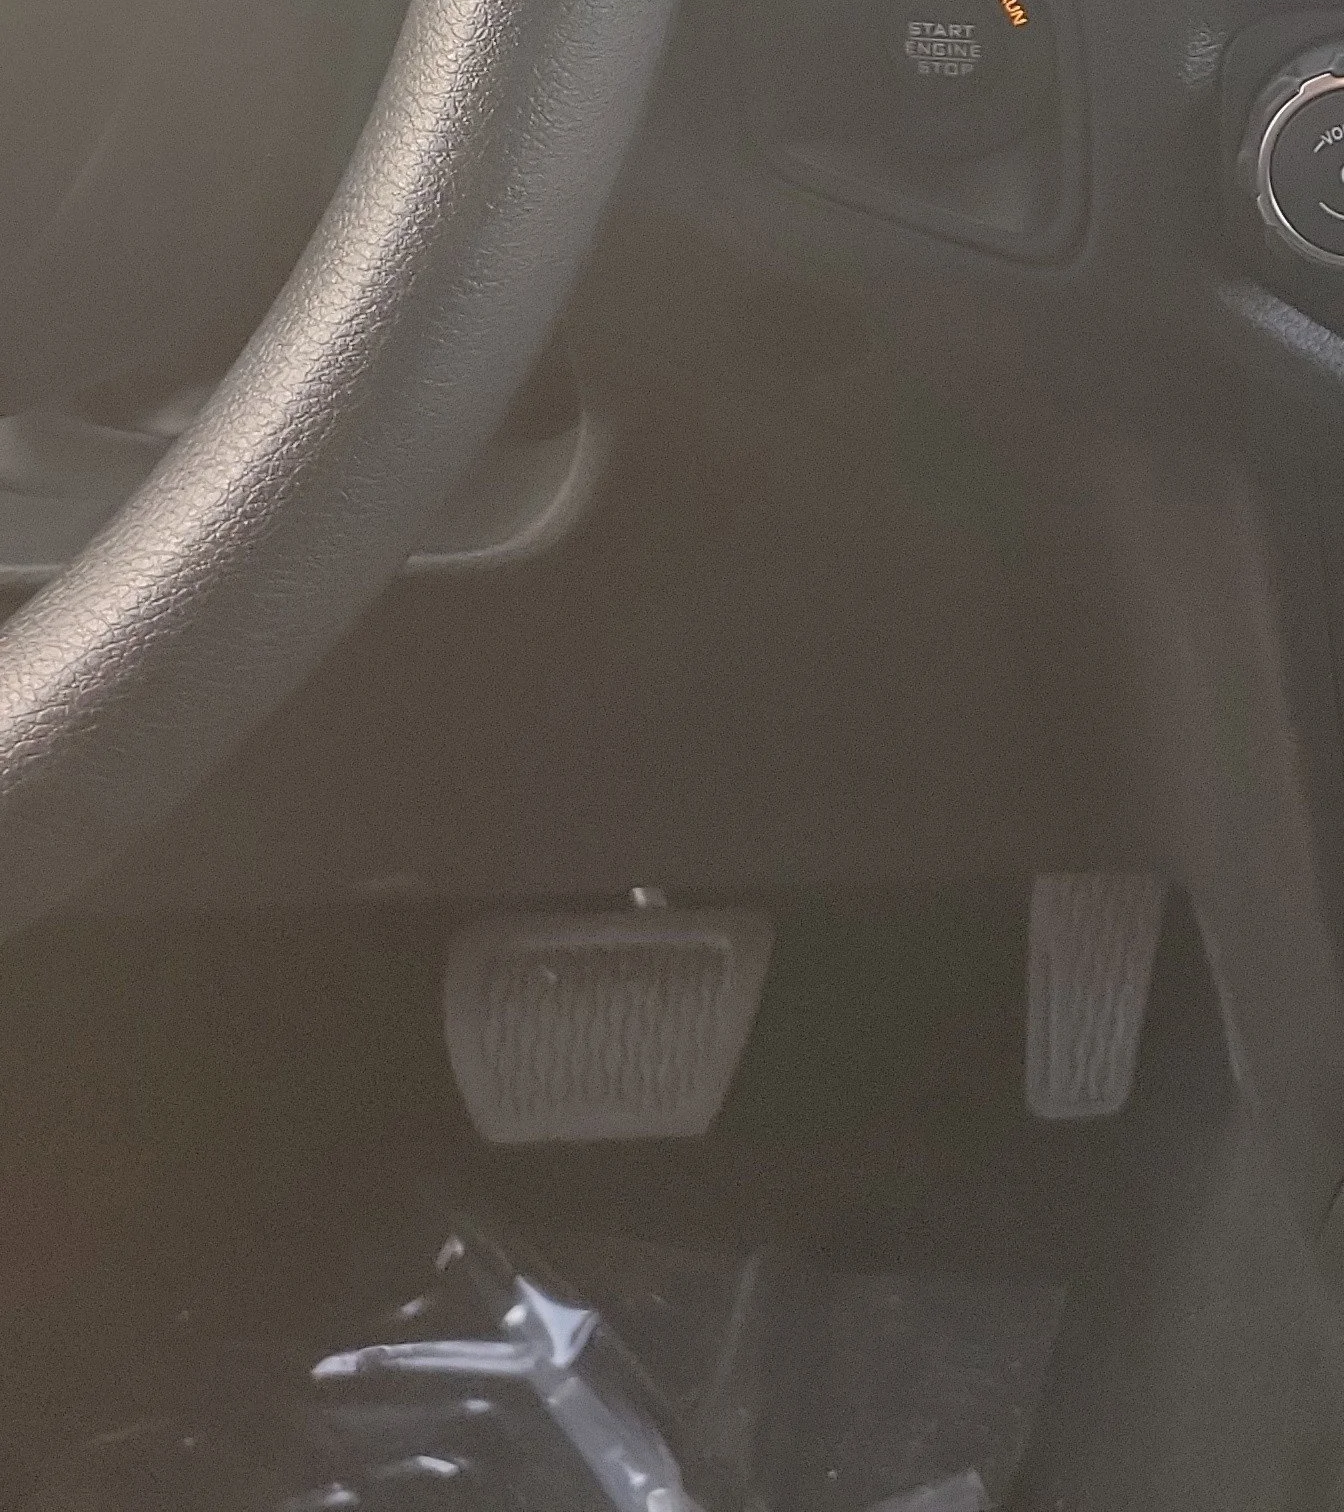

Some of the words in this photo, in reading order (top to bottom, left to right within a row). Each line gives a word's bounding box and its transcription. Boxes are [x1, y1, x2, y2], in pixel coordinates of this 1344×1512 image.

[909, 22, 975, 38] START
[906, 41, 981, 58] ENGINE
[918, 62, 974, 76] STOP
